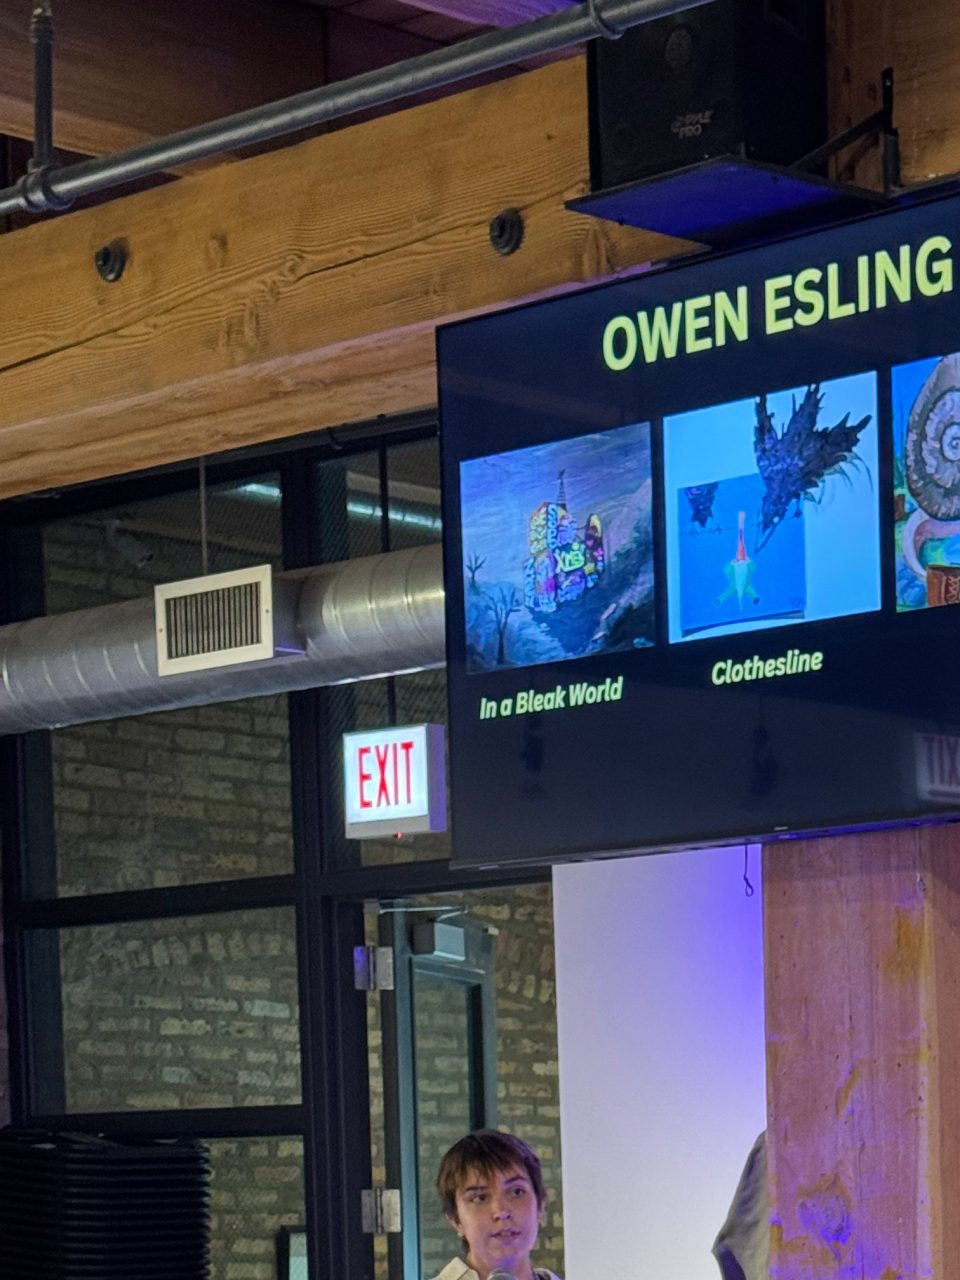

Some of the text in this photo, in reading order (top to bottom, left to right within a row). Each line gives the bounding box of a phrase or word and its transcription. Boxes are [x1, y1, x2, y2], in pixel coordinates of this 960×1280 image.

[602, 235, 954, 371] OWEN ESLING
[711, 649, 824, 685] Clothesline
[480, 675, 624, 720] In a Bleak World
[358, 741, 415, 809] EXIT
